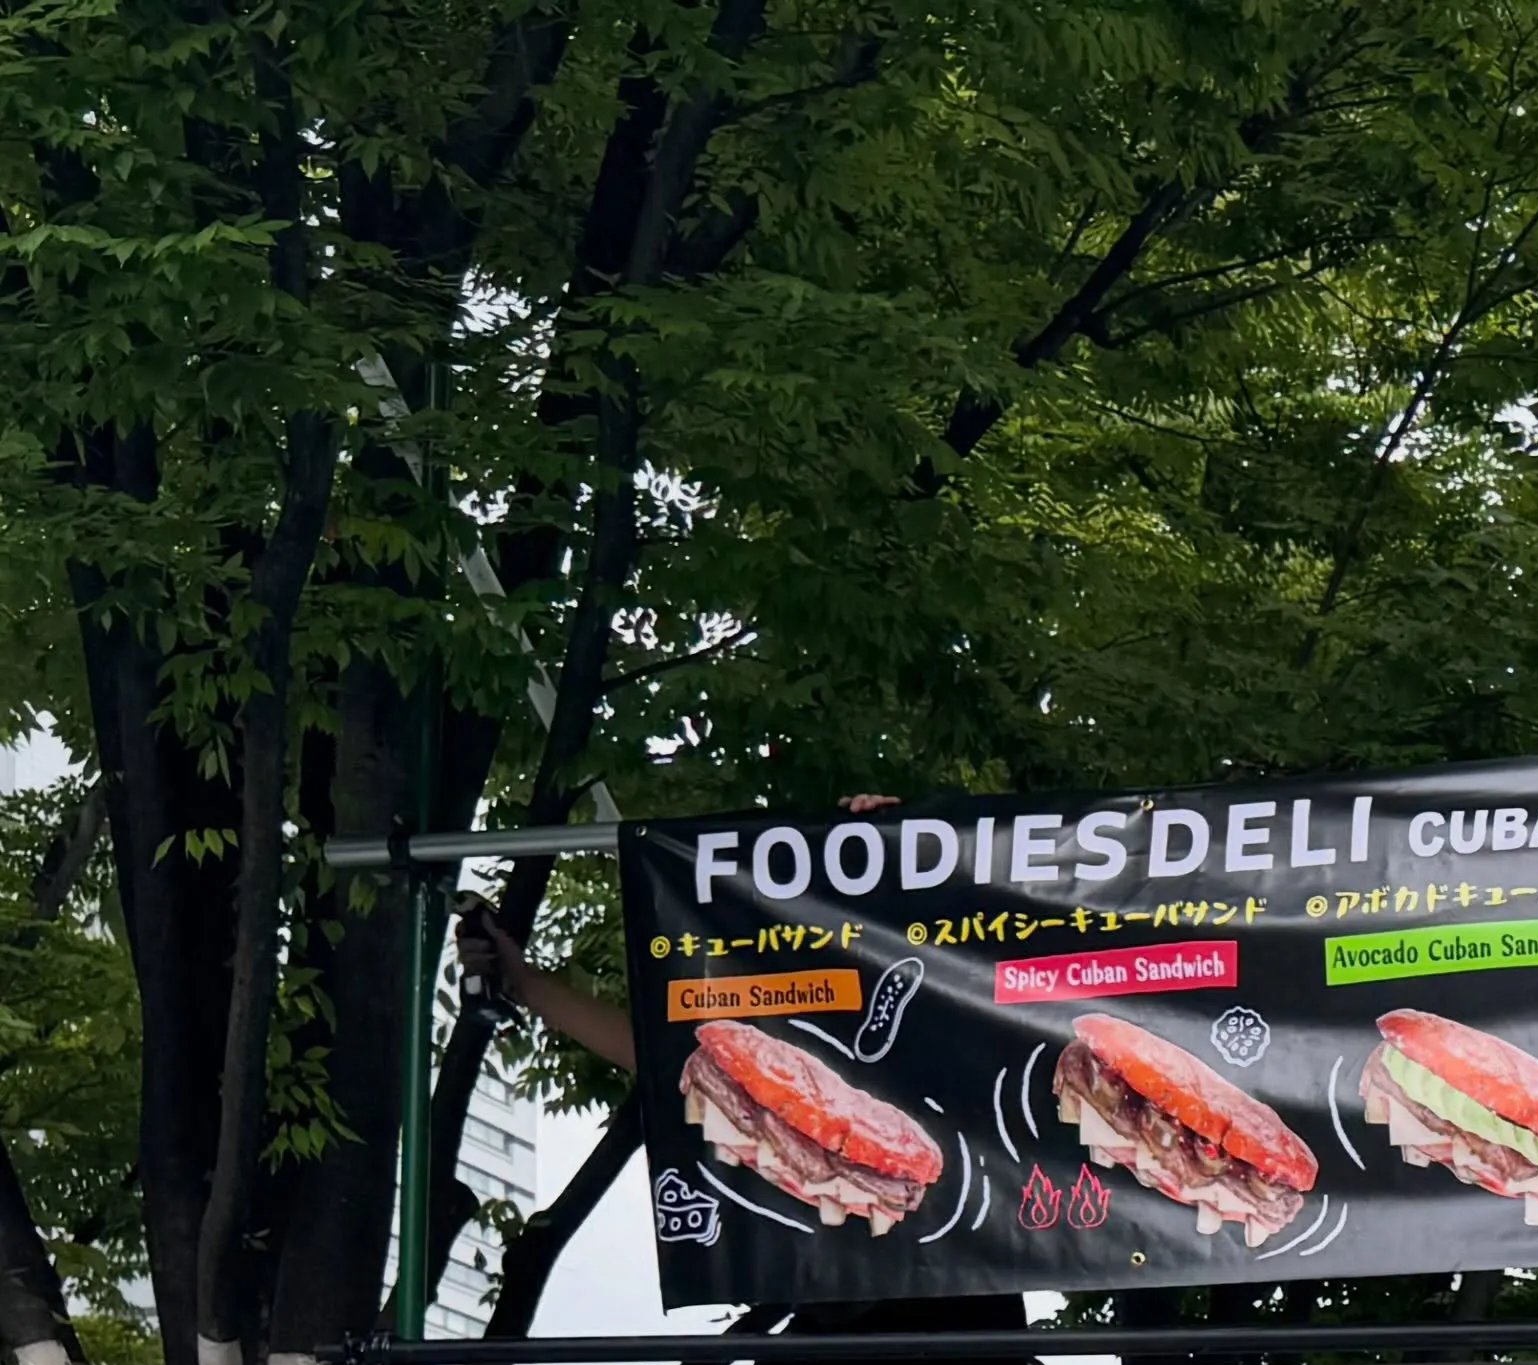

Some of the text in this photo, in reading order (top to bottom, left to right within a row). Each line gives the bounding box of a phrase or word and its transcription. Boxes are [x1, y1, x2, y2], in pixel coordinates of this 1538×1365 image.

[677, 921, 863, 957] キューバサンド
[934, 896, 1268, 946] スパイシーキューバサンド
[1333, 934, 1419, 969] Avocado
[1428, 933, 1492, 961] Cuban
[1004, 950, 1225, 992] Spicy Cuban Sandwich
[680, 981, 835, 1010] Cuban Sandwich
